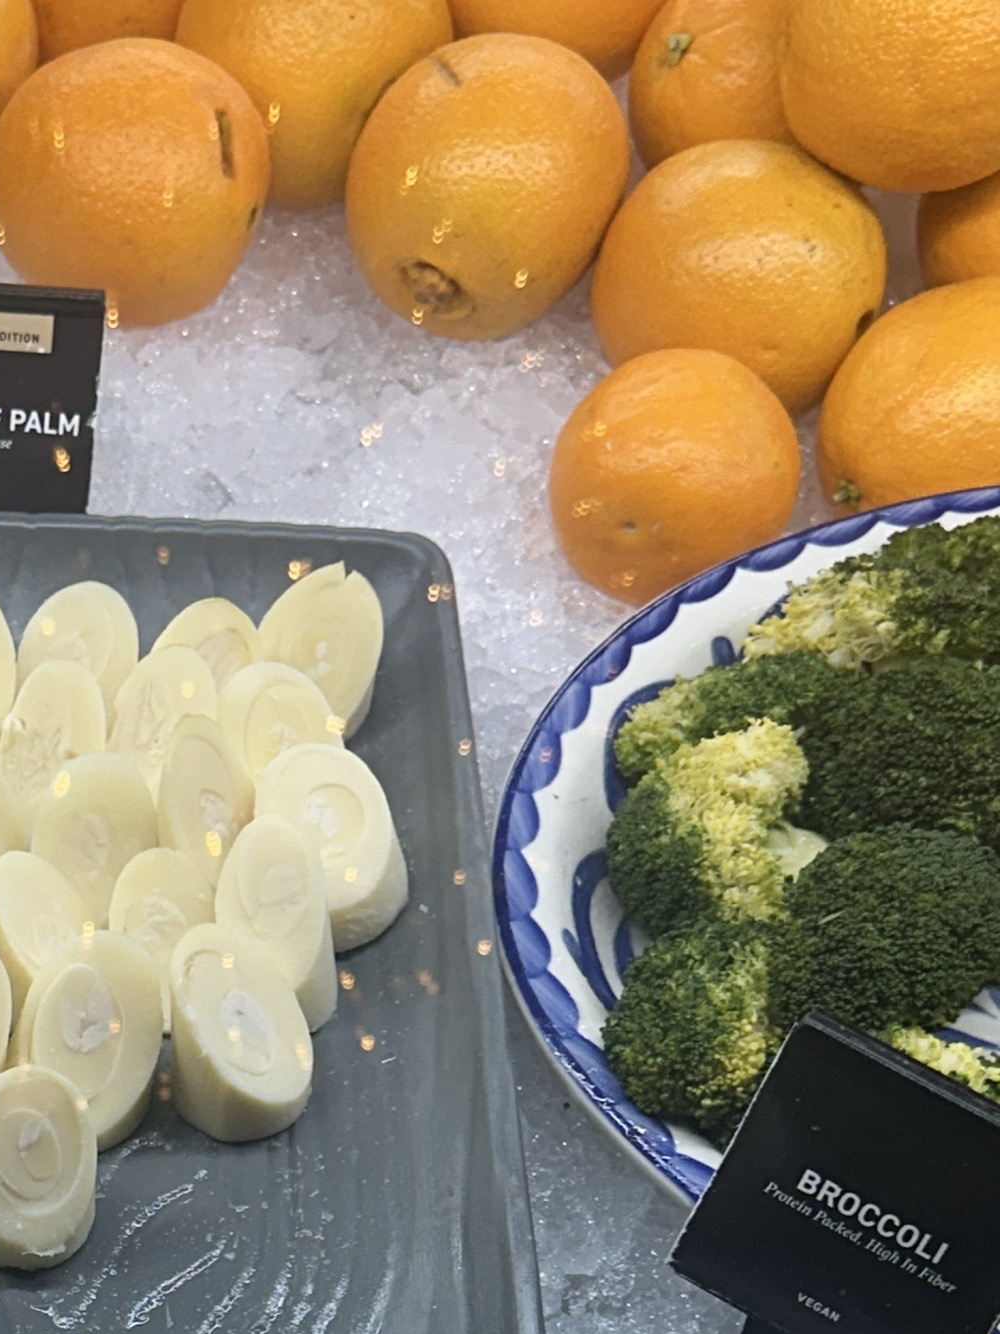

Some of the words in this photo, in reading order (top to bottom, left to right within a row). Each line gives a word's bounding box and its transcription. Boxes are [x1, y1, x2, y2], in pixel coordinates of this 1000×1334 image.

[9, 410, 80, 437] PALM
[763, 1181, 812, 1217] Protein
[813, 1209, 862, 1246] Packed,
[865, 1238, 900, 1265] High
[900, 1257, 918, 1274] In
[918, 1266, 958, 1293] Fiber
[796, 1168, 949, 1265] BROCCOLI
[798, 1292, 841, 1322] VEGAN
